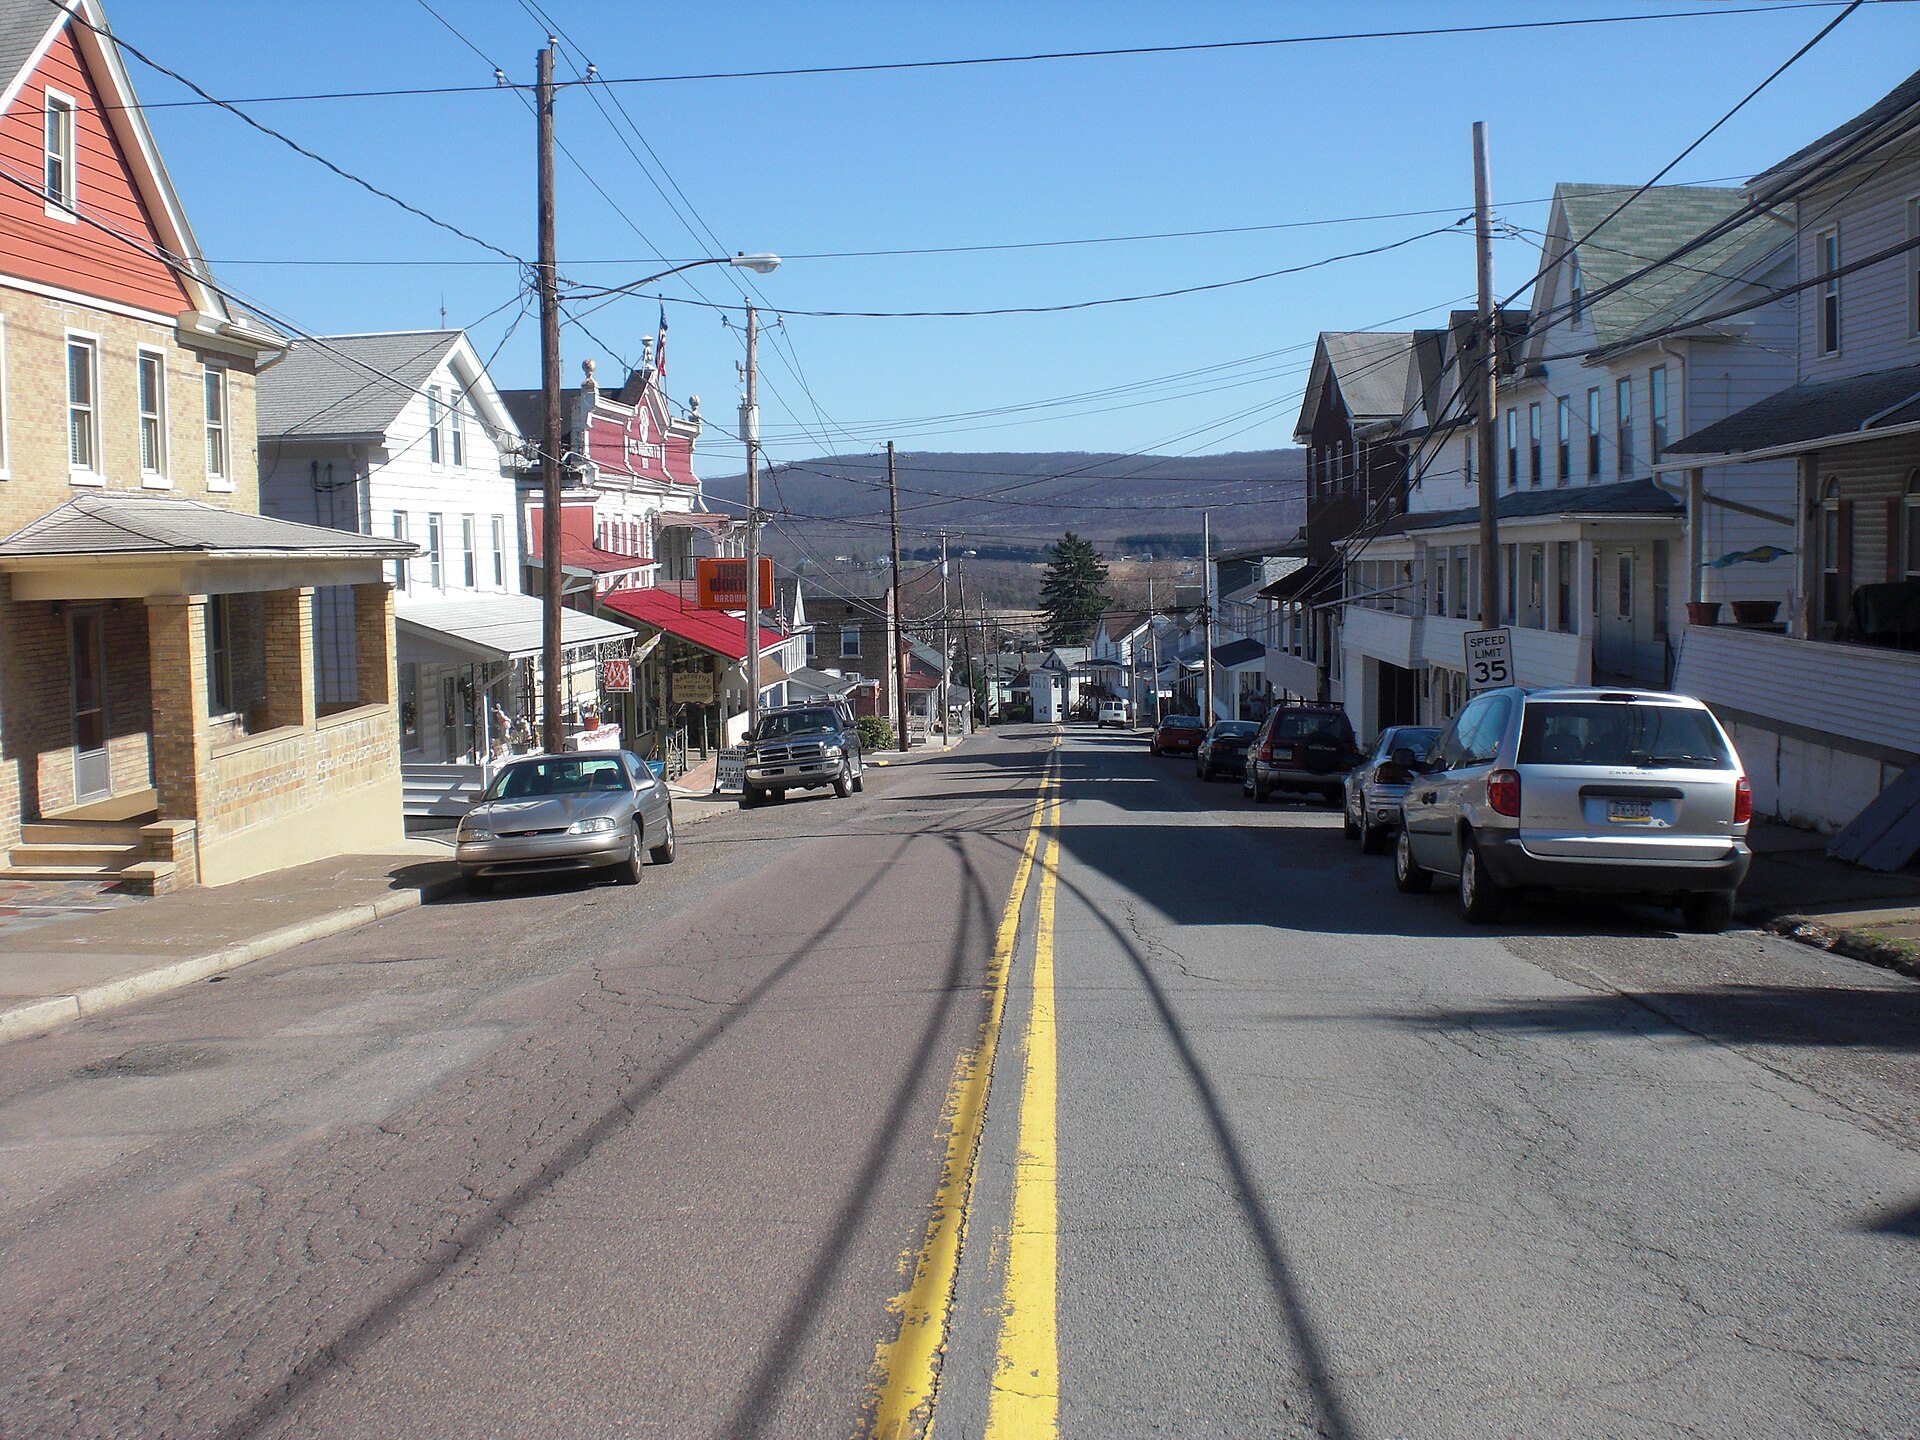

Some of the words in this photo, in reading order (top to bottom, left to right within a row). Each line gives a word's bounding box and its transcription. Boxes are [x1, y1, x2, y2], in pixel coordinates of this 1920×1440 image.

[716, 564, 748, 577] TRUS
[1470, 635, 1506, 648] SPEED
[1474, 647, 1502, 659] LIMIT
[1474, 659, 1507, 683] 35
